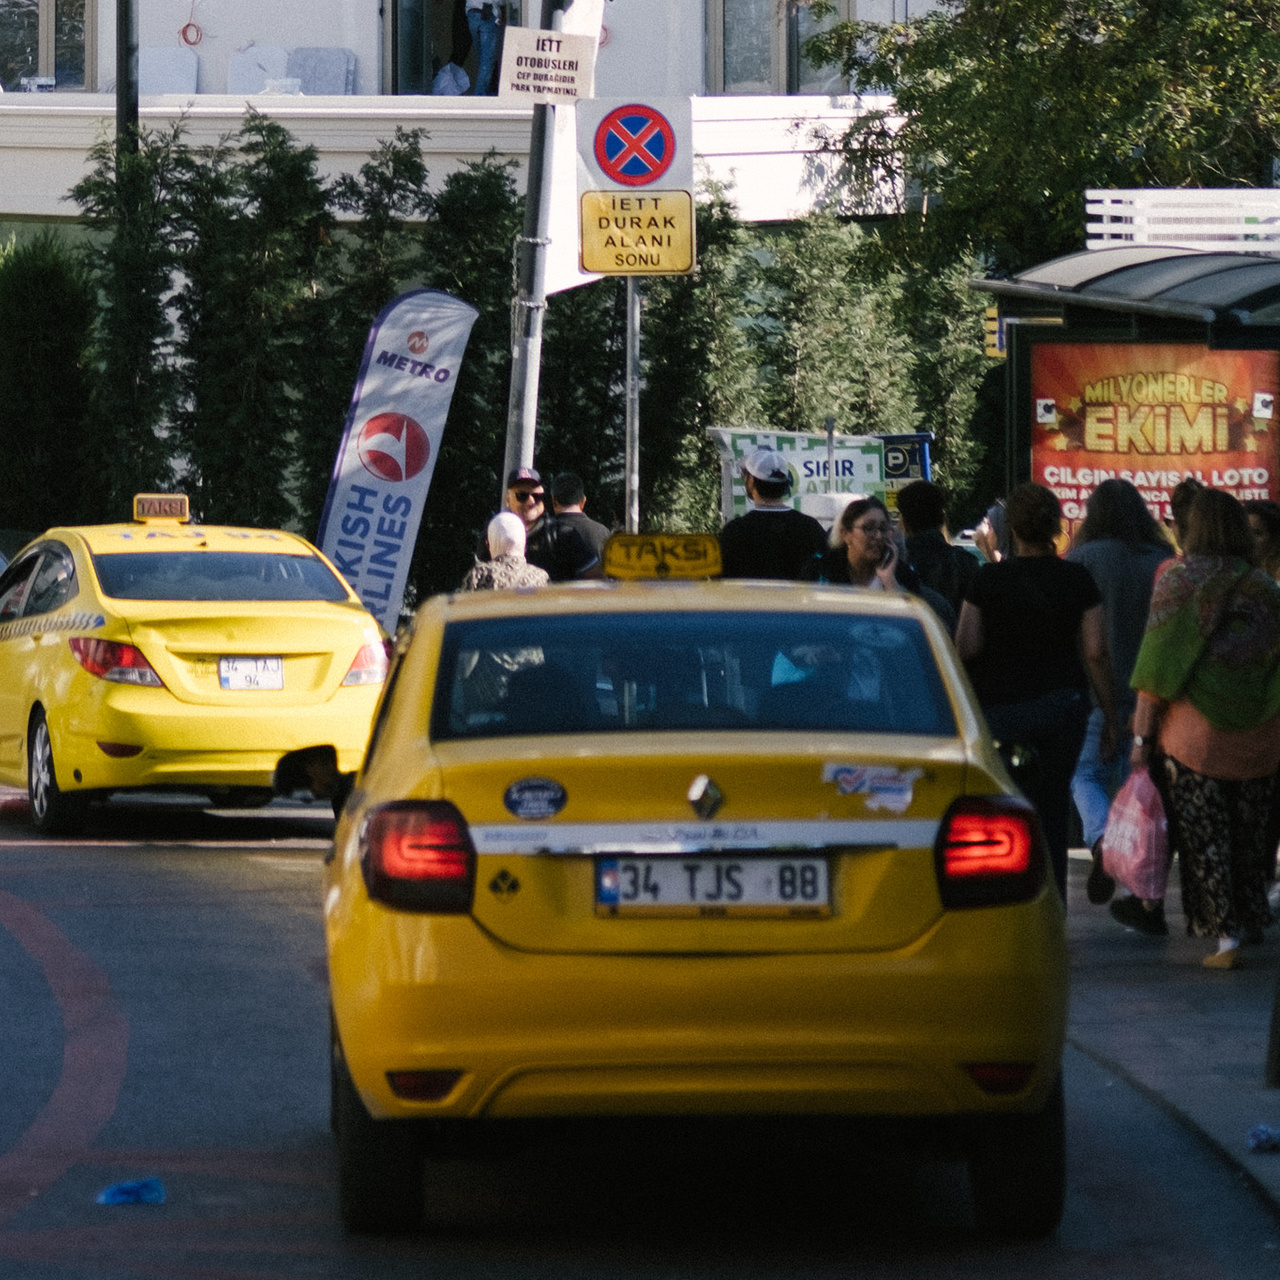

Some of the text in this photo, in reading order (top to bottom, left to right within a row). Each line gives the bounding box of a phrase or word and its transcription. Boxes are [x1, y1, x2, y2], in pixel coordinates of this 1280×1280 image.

[536, 36, 563, 53] İETT
[612, 195, 662, 211] İETT
[598, 216, 676, 230] DURAK
[604, 235, 671, 248] ALANI
[615, 254, 660, 267] SONU
[375, 350, 451, 384] METRO
[1043, 466, 1116, 486] ÇILGIN
[1211, 467, 1269, 486] LOTO
[335, 483, 380, 591] KISH
[244, 674, 260, 687] 94
[622, 863, 819, 902] 34 TJS 88
